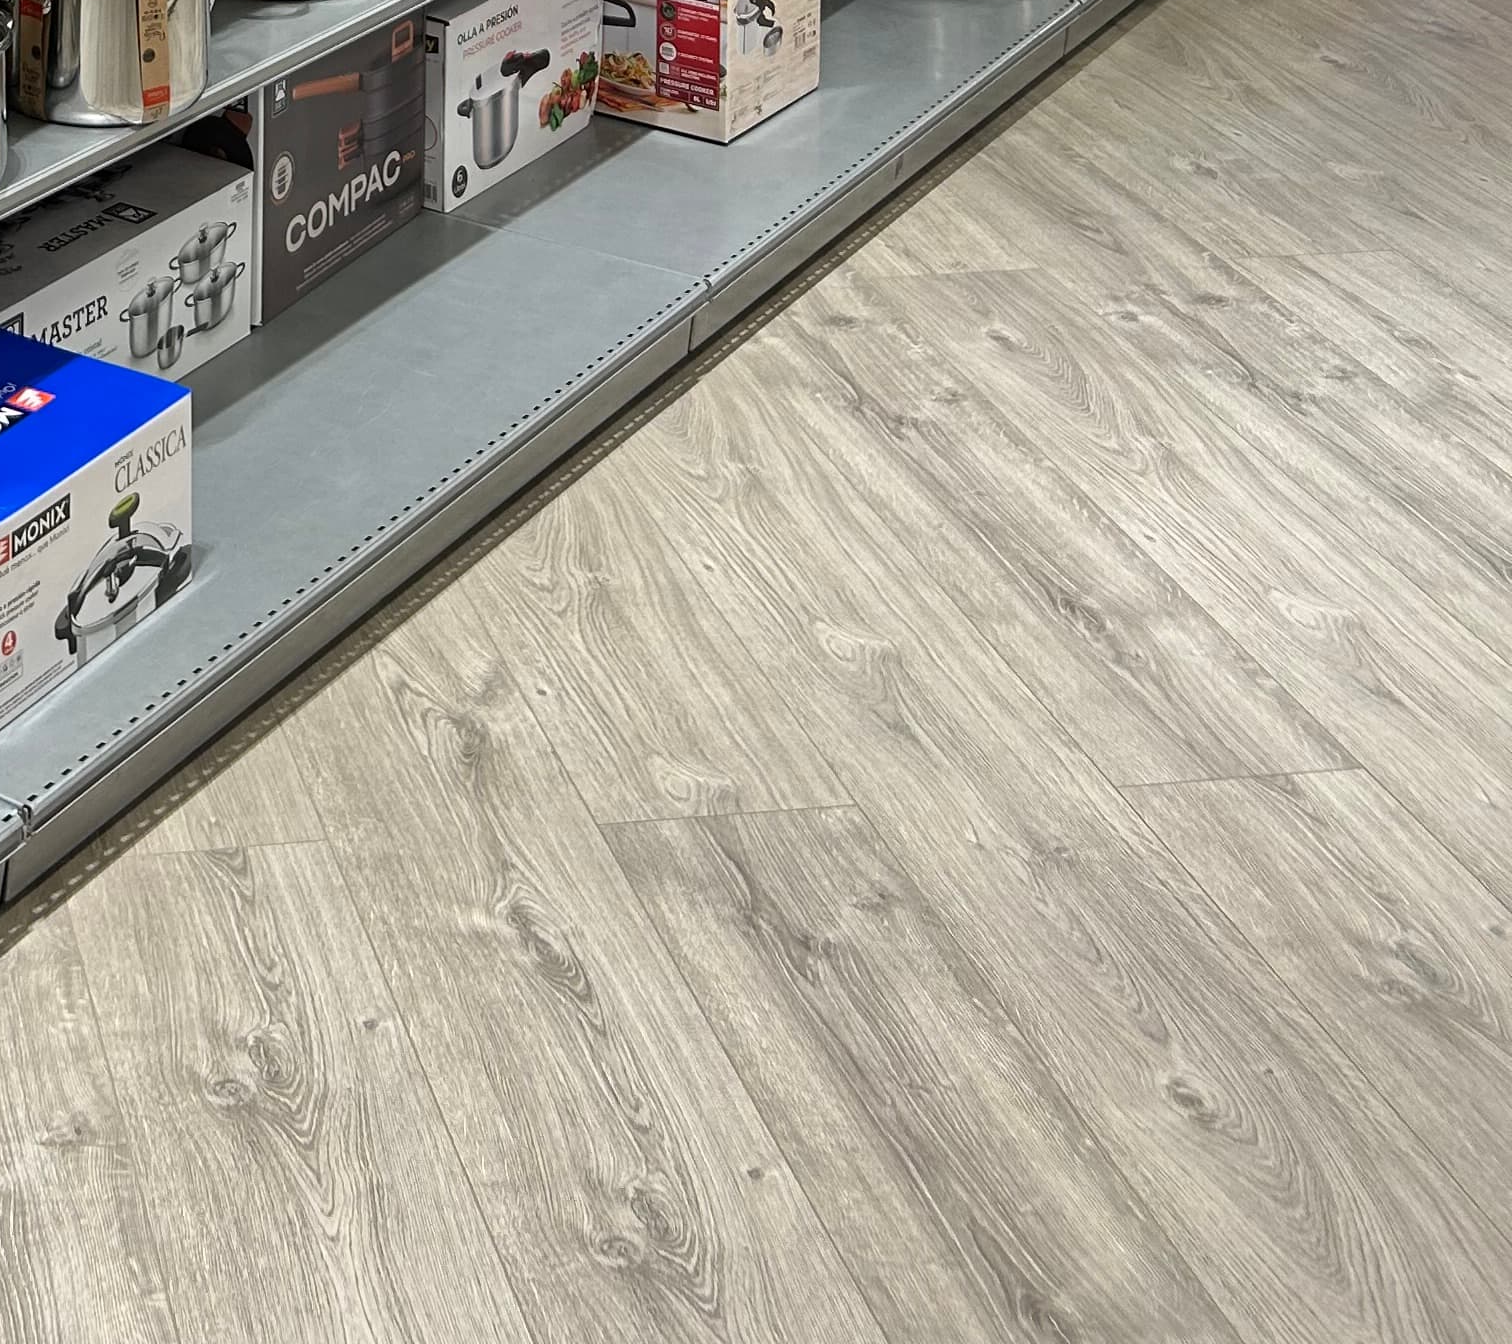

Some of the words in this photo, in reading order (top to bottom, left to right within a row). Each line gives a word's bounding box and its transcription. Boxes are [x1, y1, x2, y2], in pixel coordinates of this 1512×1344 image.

[457, 26, 478, 46] OLLA
[478, 23, 485, 34] A
[485, 4, 519, 30] PRESIÓN
[286, 151, 401, 253] COMPAC
[38, 213, 115, 252] MASTER
[31, 295, 108, 346] MASTER
[114, 424, 187, 494] CLASSICA
[14, 502, 67, 554] MONIX
